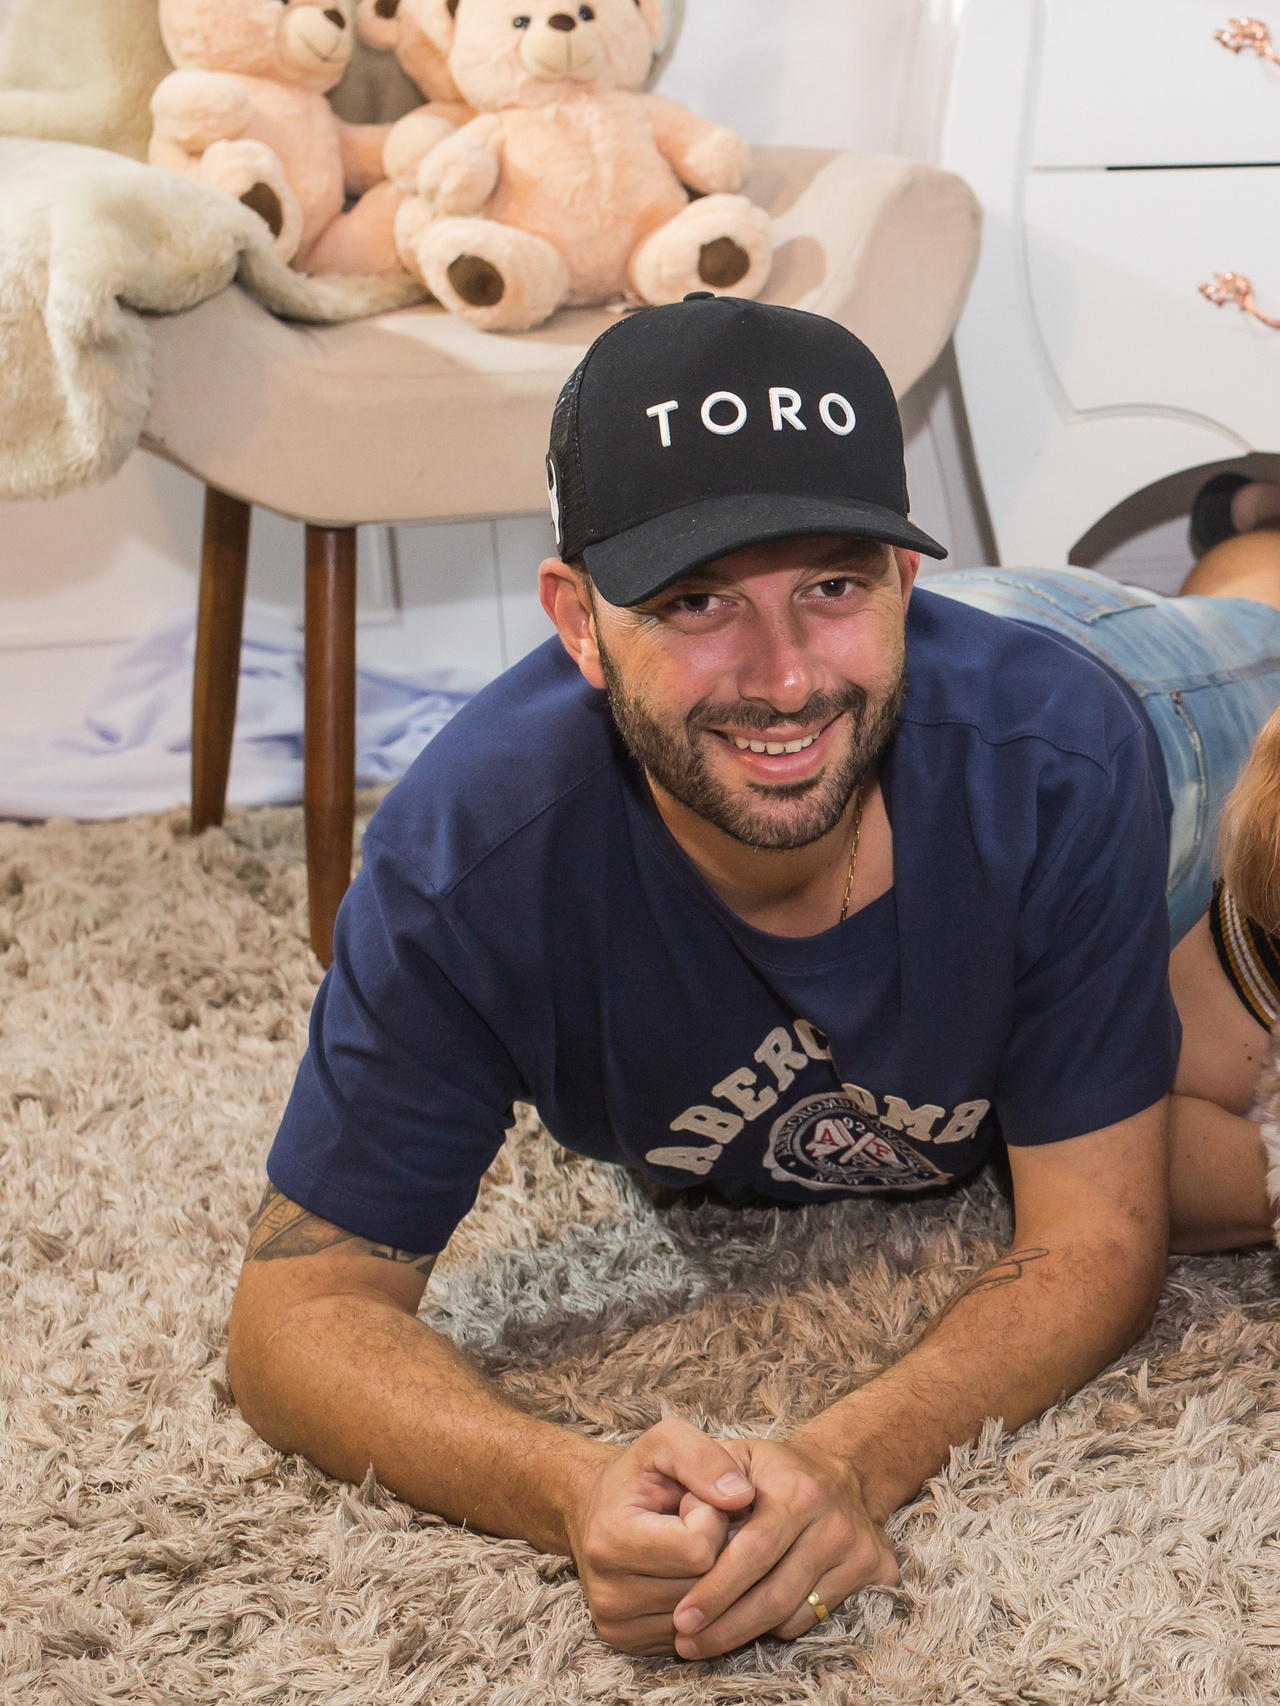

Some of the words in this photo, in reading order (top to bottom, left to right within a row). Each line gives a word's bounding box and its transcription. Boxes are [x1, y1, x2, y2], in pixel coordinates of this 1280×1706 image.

[646, 387, 856, 448] TORO
[842, 1116, 867, 1134] 92
[816, 1127, 839, 1146] A
[872, 1141, 892, 1158] F
